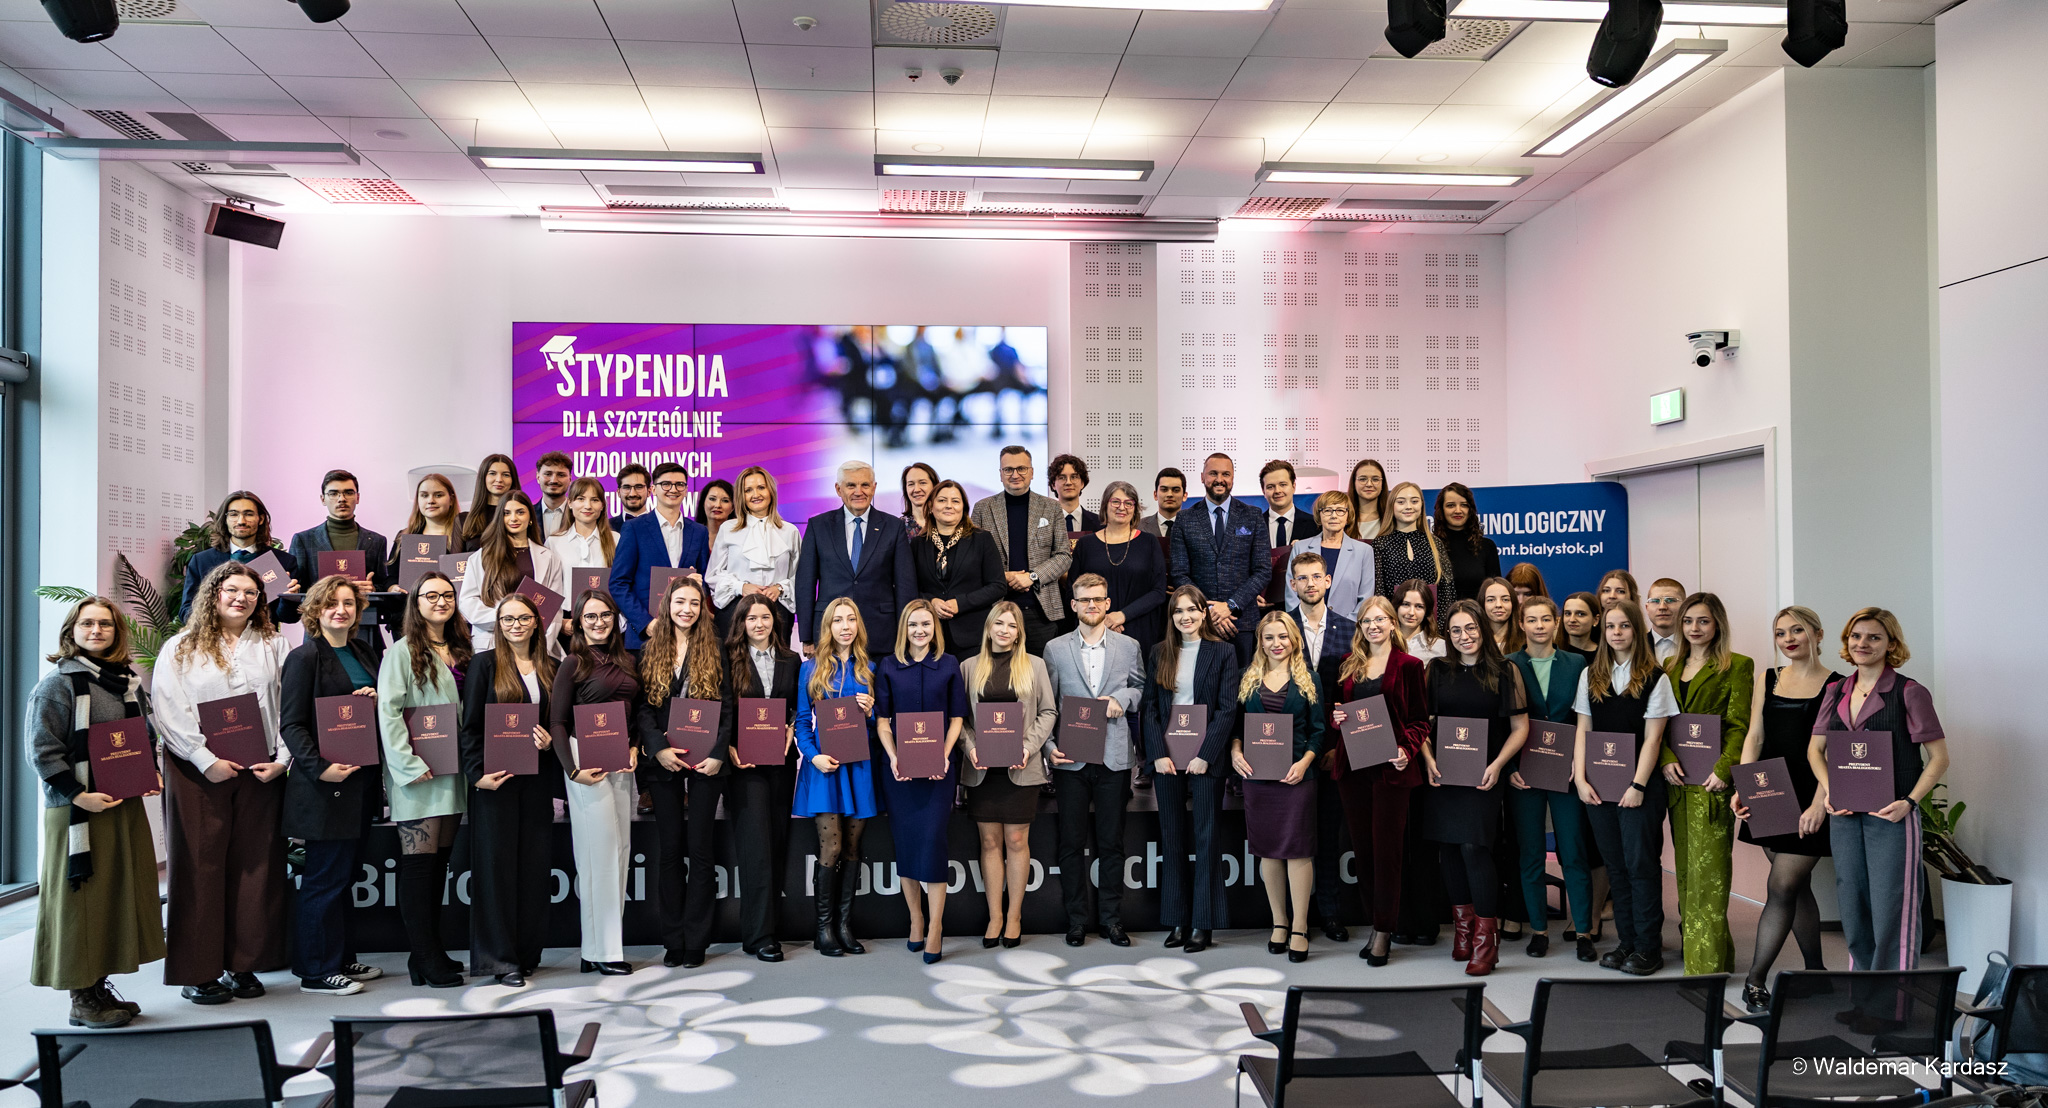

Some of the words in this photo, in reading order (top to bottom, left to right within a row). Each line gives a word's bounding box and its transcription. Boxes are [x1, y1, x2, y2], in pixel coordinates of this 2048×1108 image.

[556, 353, 729, 398] STYPENDIA
[562, 410, 599, 438] DLA
[603, 405, 723, 438] SZCZEGÓLNIE
[1476, 509, 1607, 536] HNOLOGICZNY
